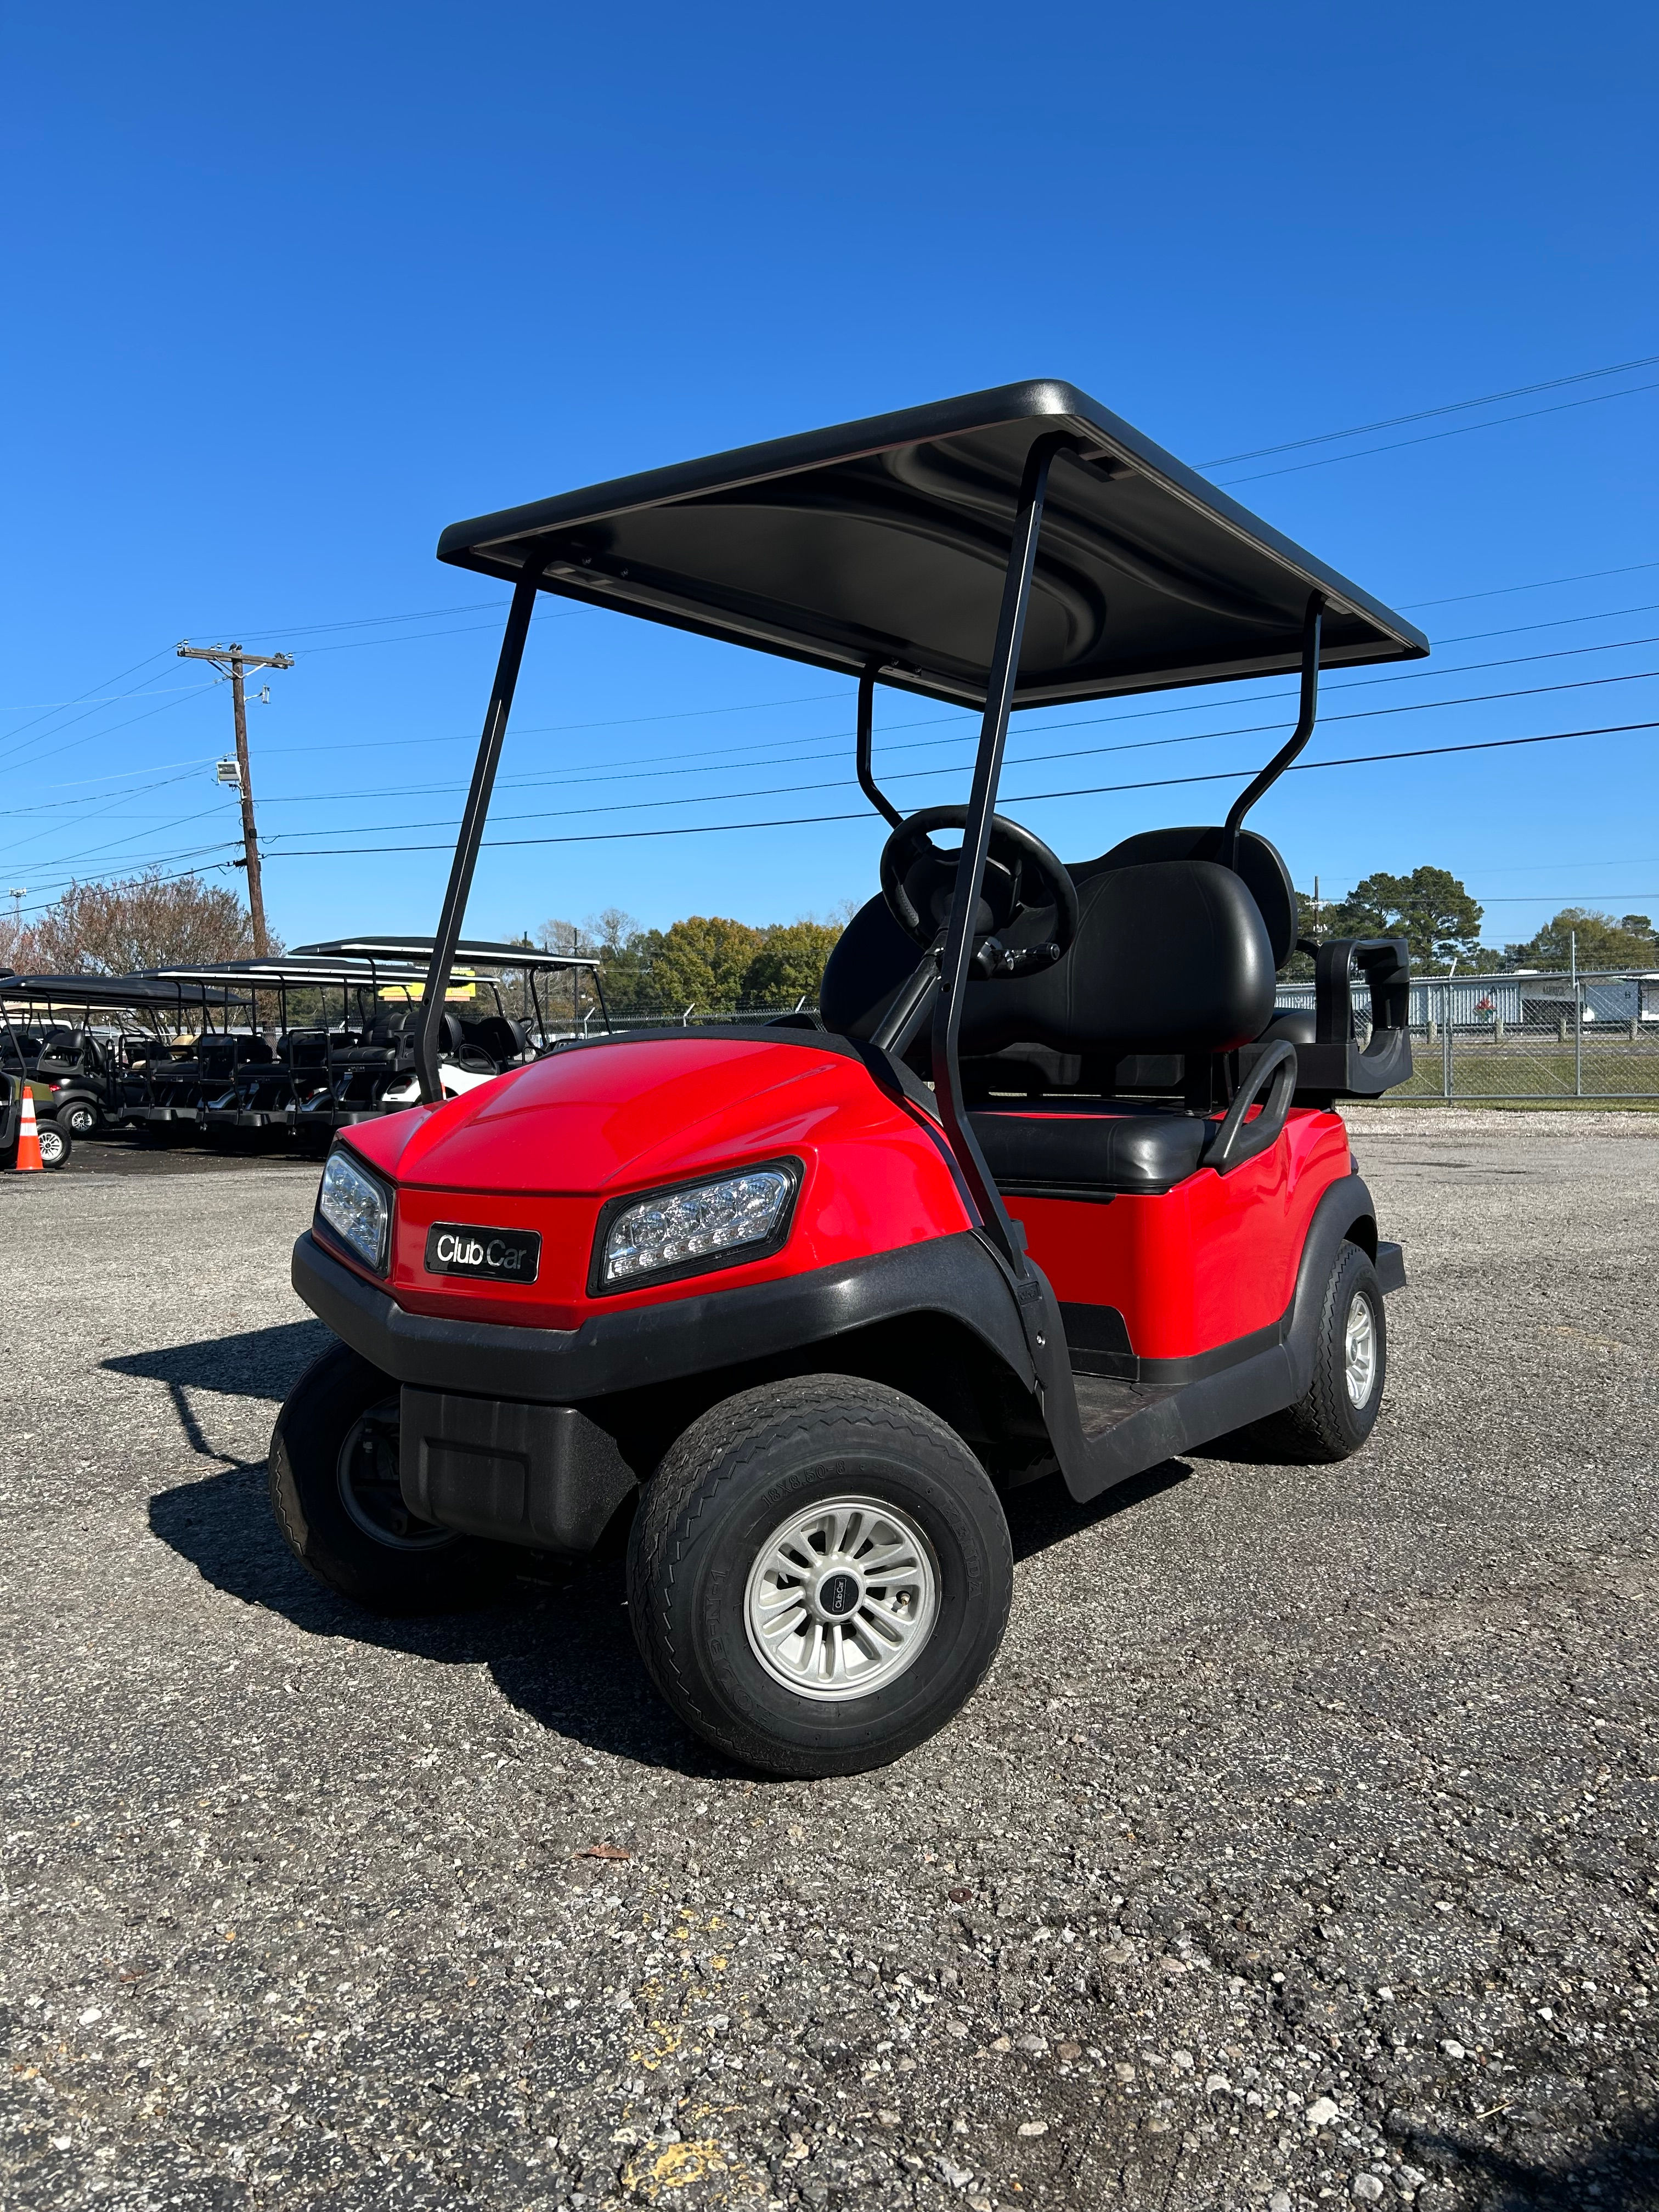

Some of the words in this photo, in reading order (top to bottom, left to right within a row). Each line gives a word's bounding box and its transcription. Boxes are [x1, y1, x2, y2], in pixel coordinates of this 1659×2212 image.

[437, 1234, 484, 1265] Club
[486, 1239, 527, 1269] Car
[761, 1459, 846, 1508] 18X8.50-8
[938, 1499, 983, 1601] KENDA
